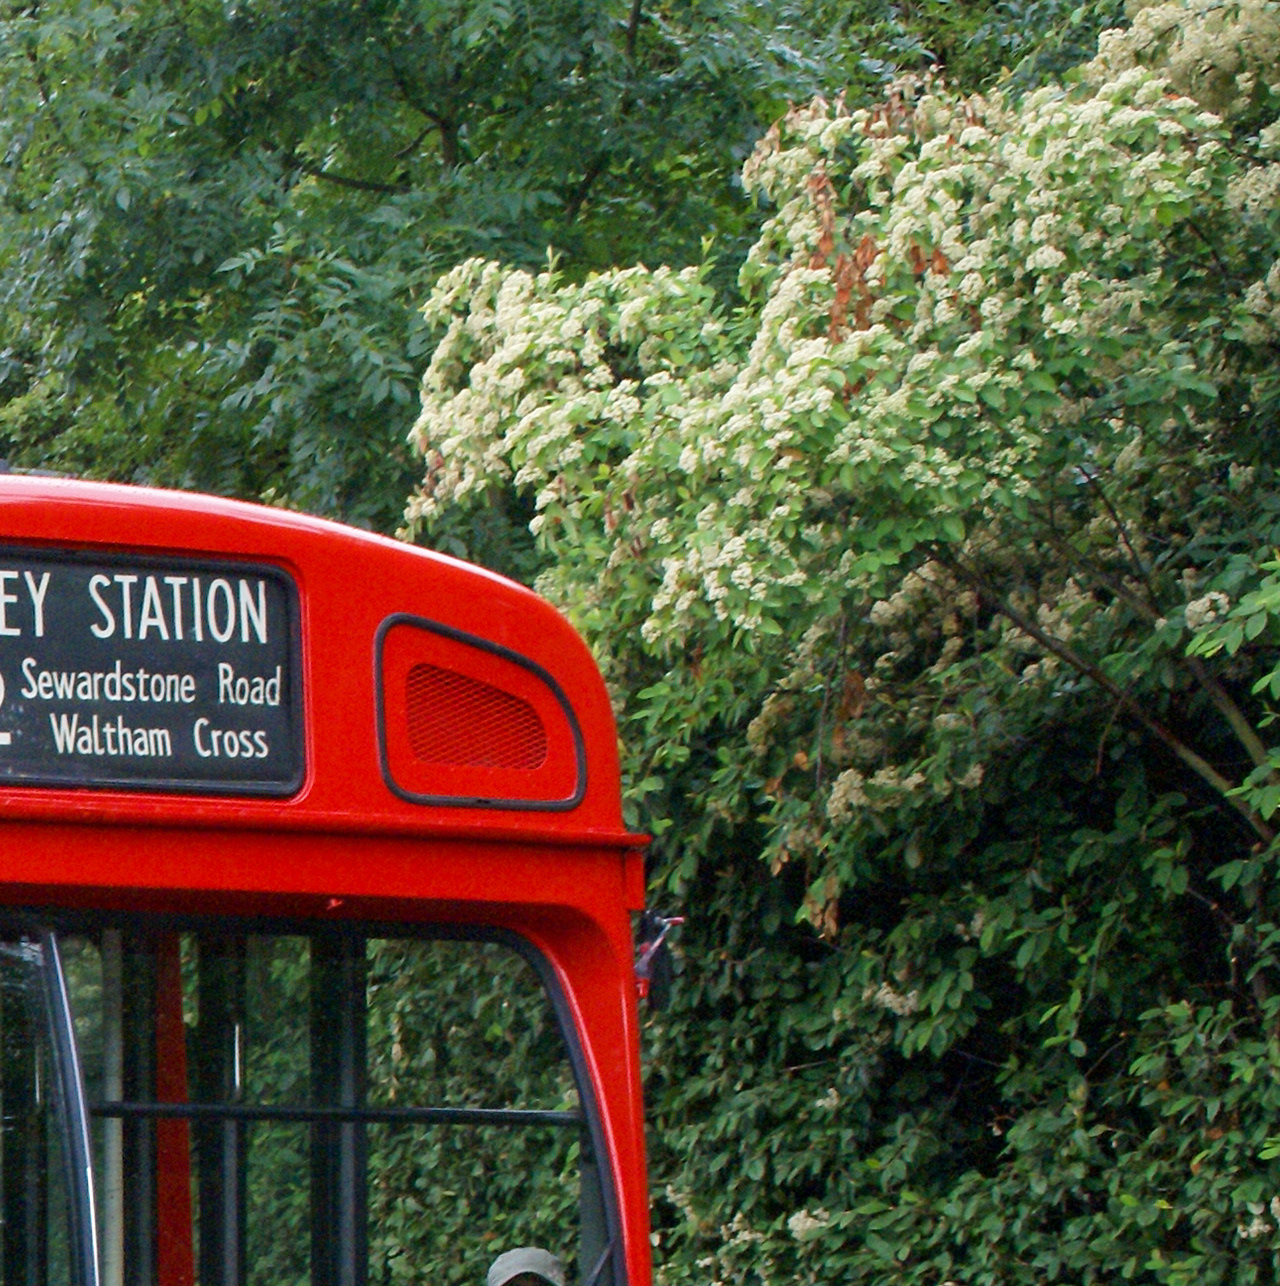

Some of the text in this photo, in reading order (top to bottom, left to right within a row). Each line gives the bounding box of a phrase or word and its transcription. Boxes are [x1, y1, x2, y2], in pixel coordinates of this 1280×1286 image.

[88, 574, 268, 644] STATION
[21, 657, 281, 706] Sewardstone Road
[50, 712, 269, 758] Waltham Cross
